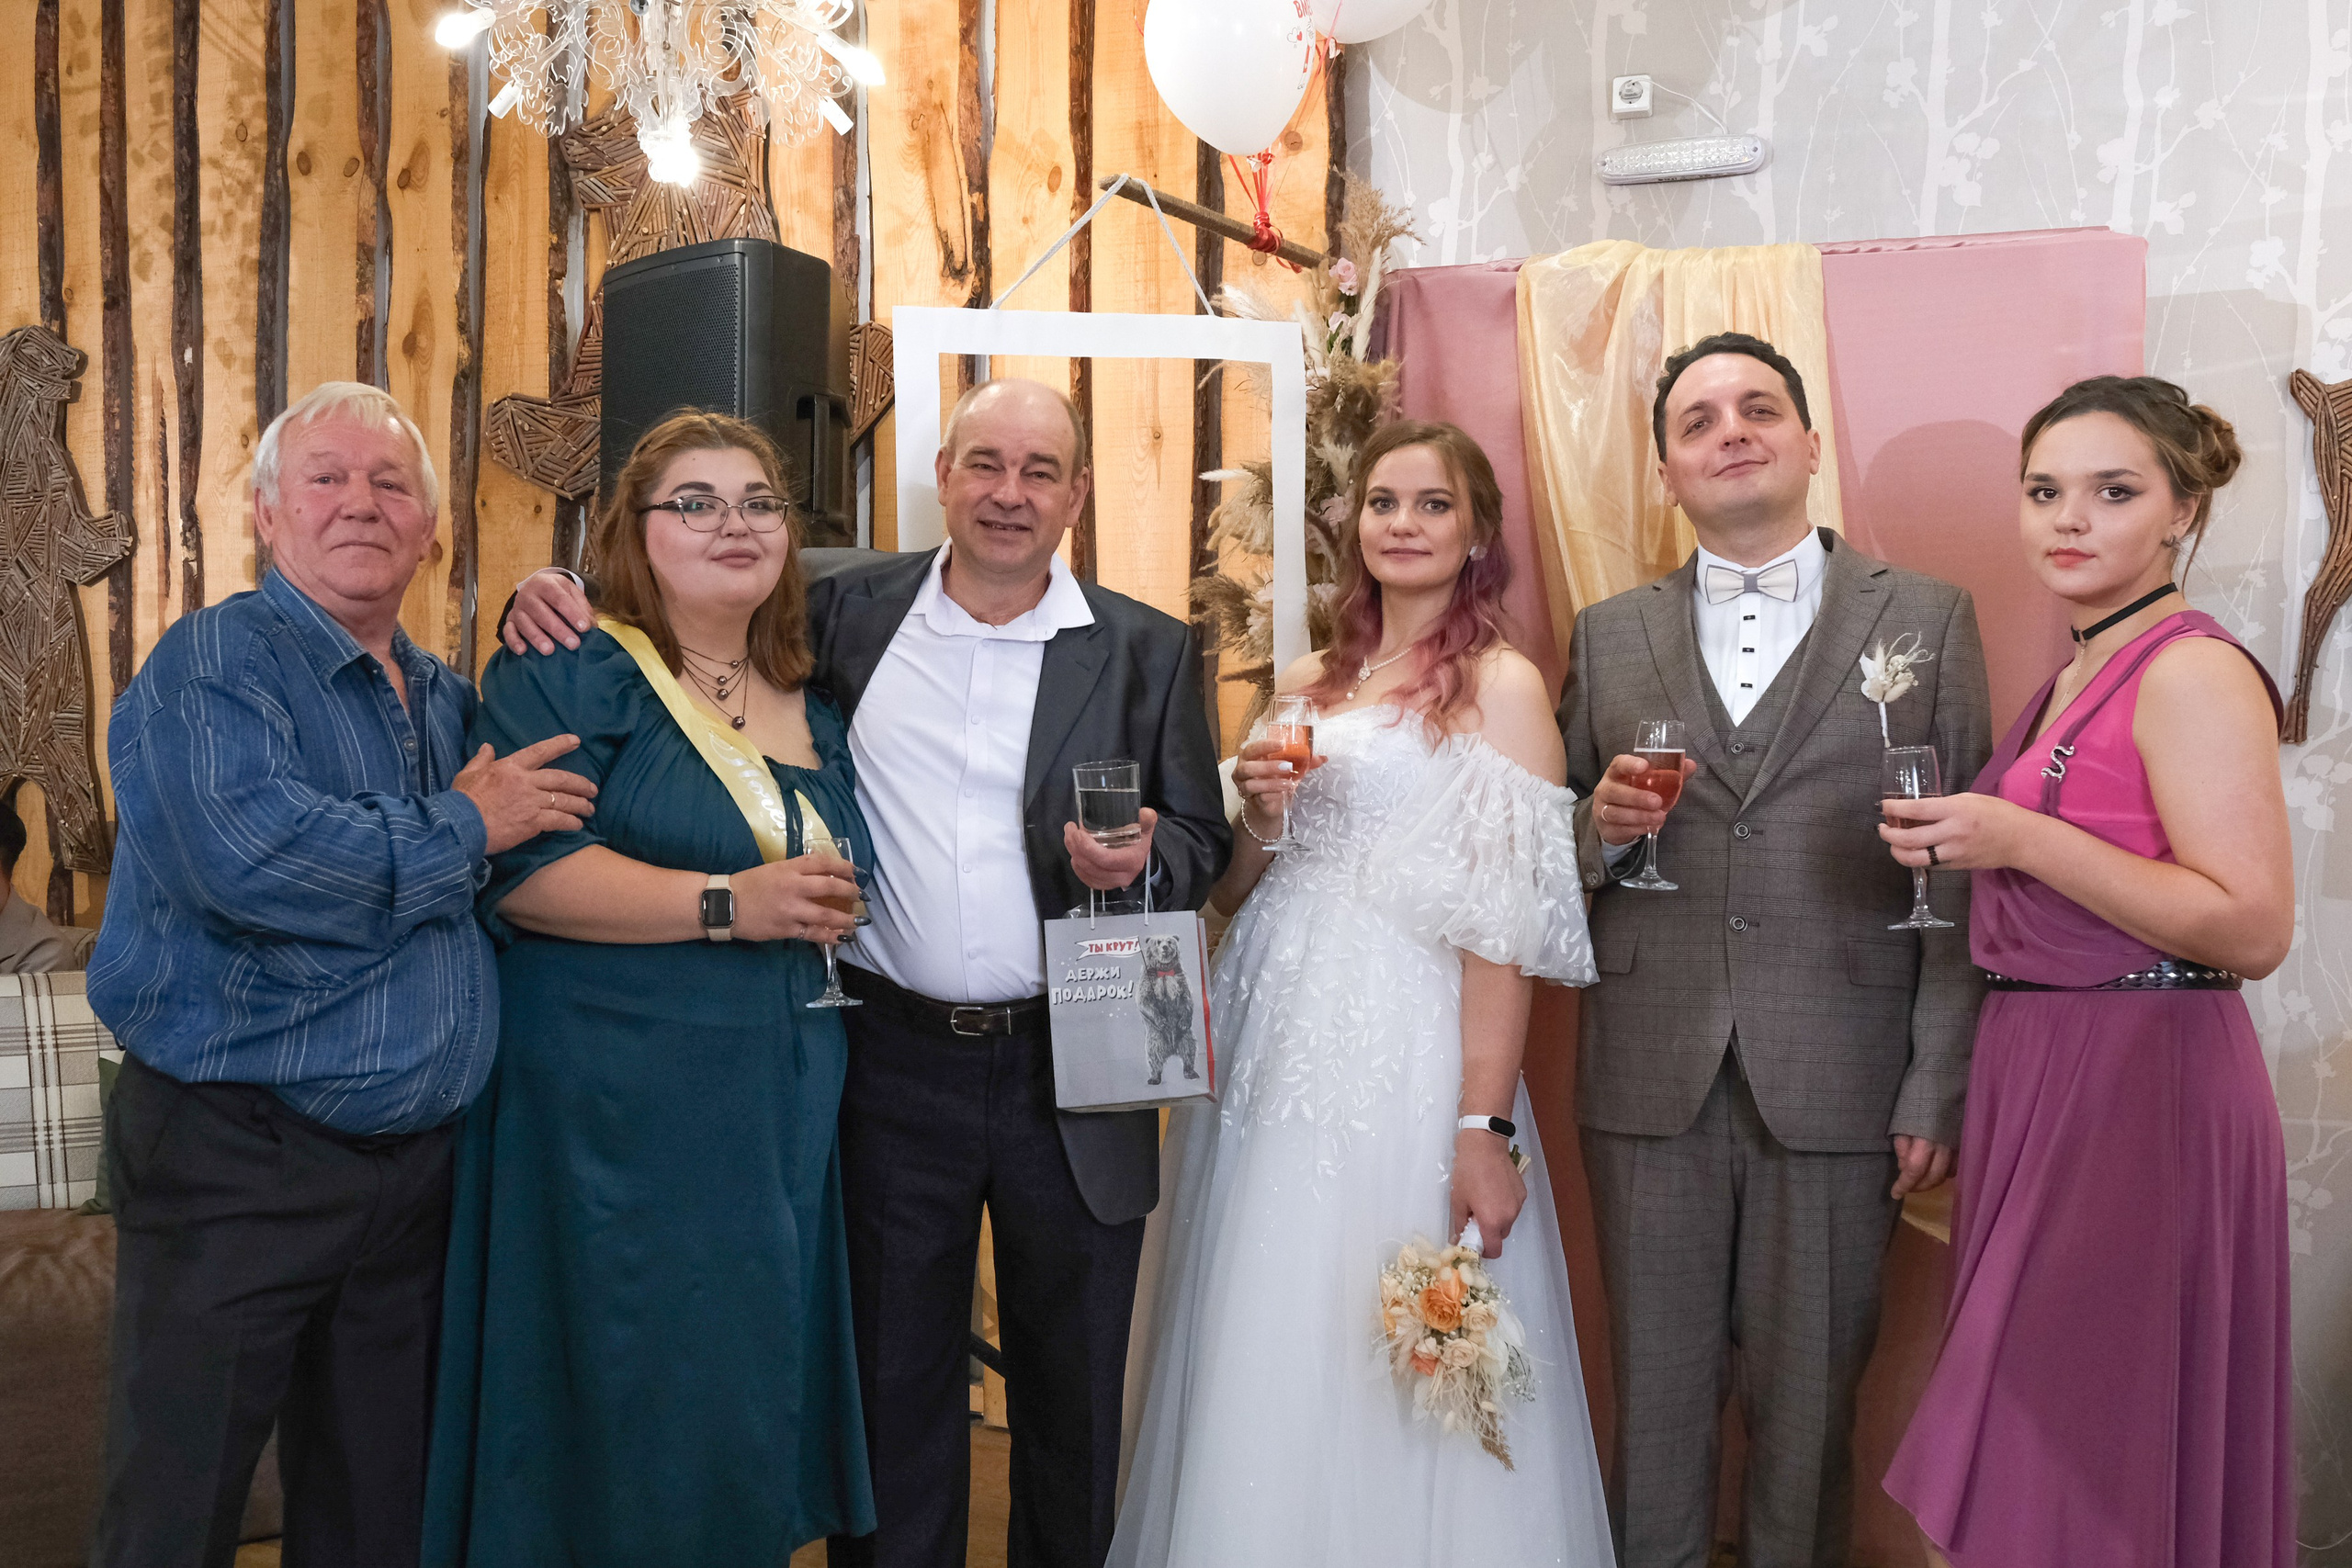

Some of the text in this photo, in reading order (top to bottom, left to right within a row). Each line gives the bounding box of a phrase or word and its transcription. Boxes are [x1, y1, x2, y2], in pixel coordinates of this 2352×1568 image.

[1089, 941, 1139, 953] ТЫ КРУТ!
[1065, 966, 1121, 983] ДЕРЖИ
[1051, 979, 1134, 1005] ПОДАРОК!
